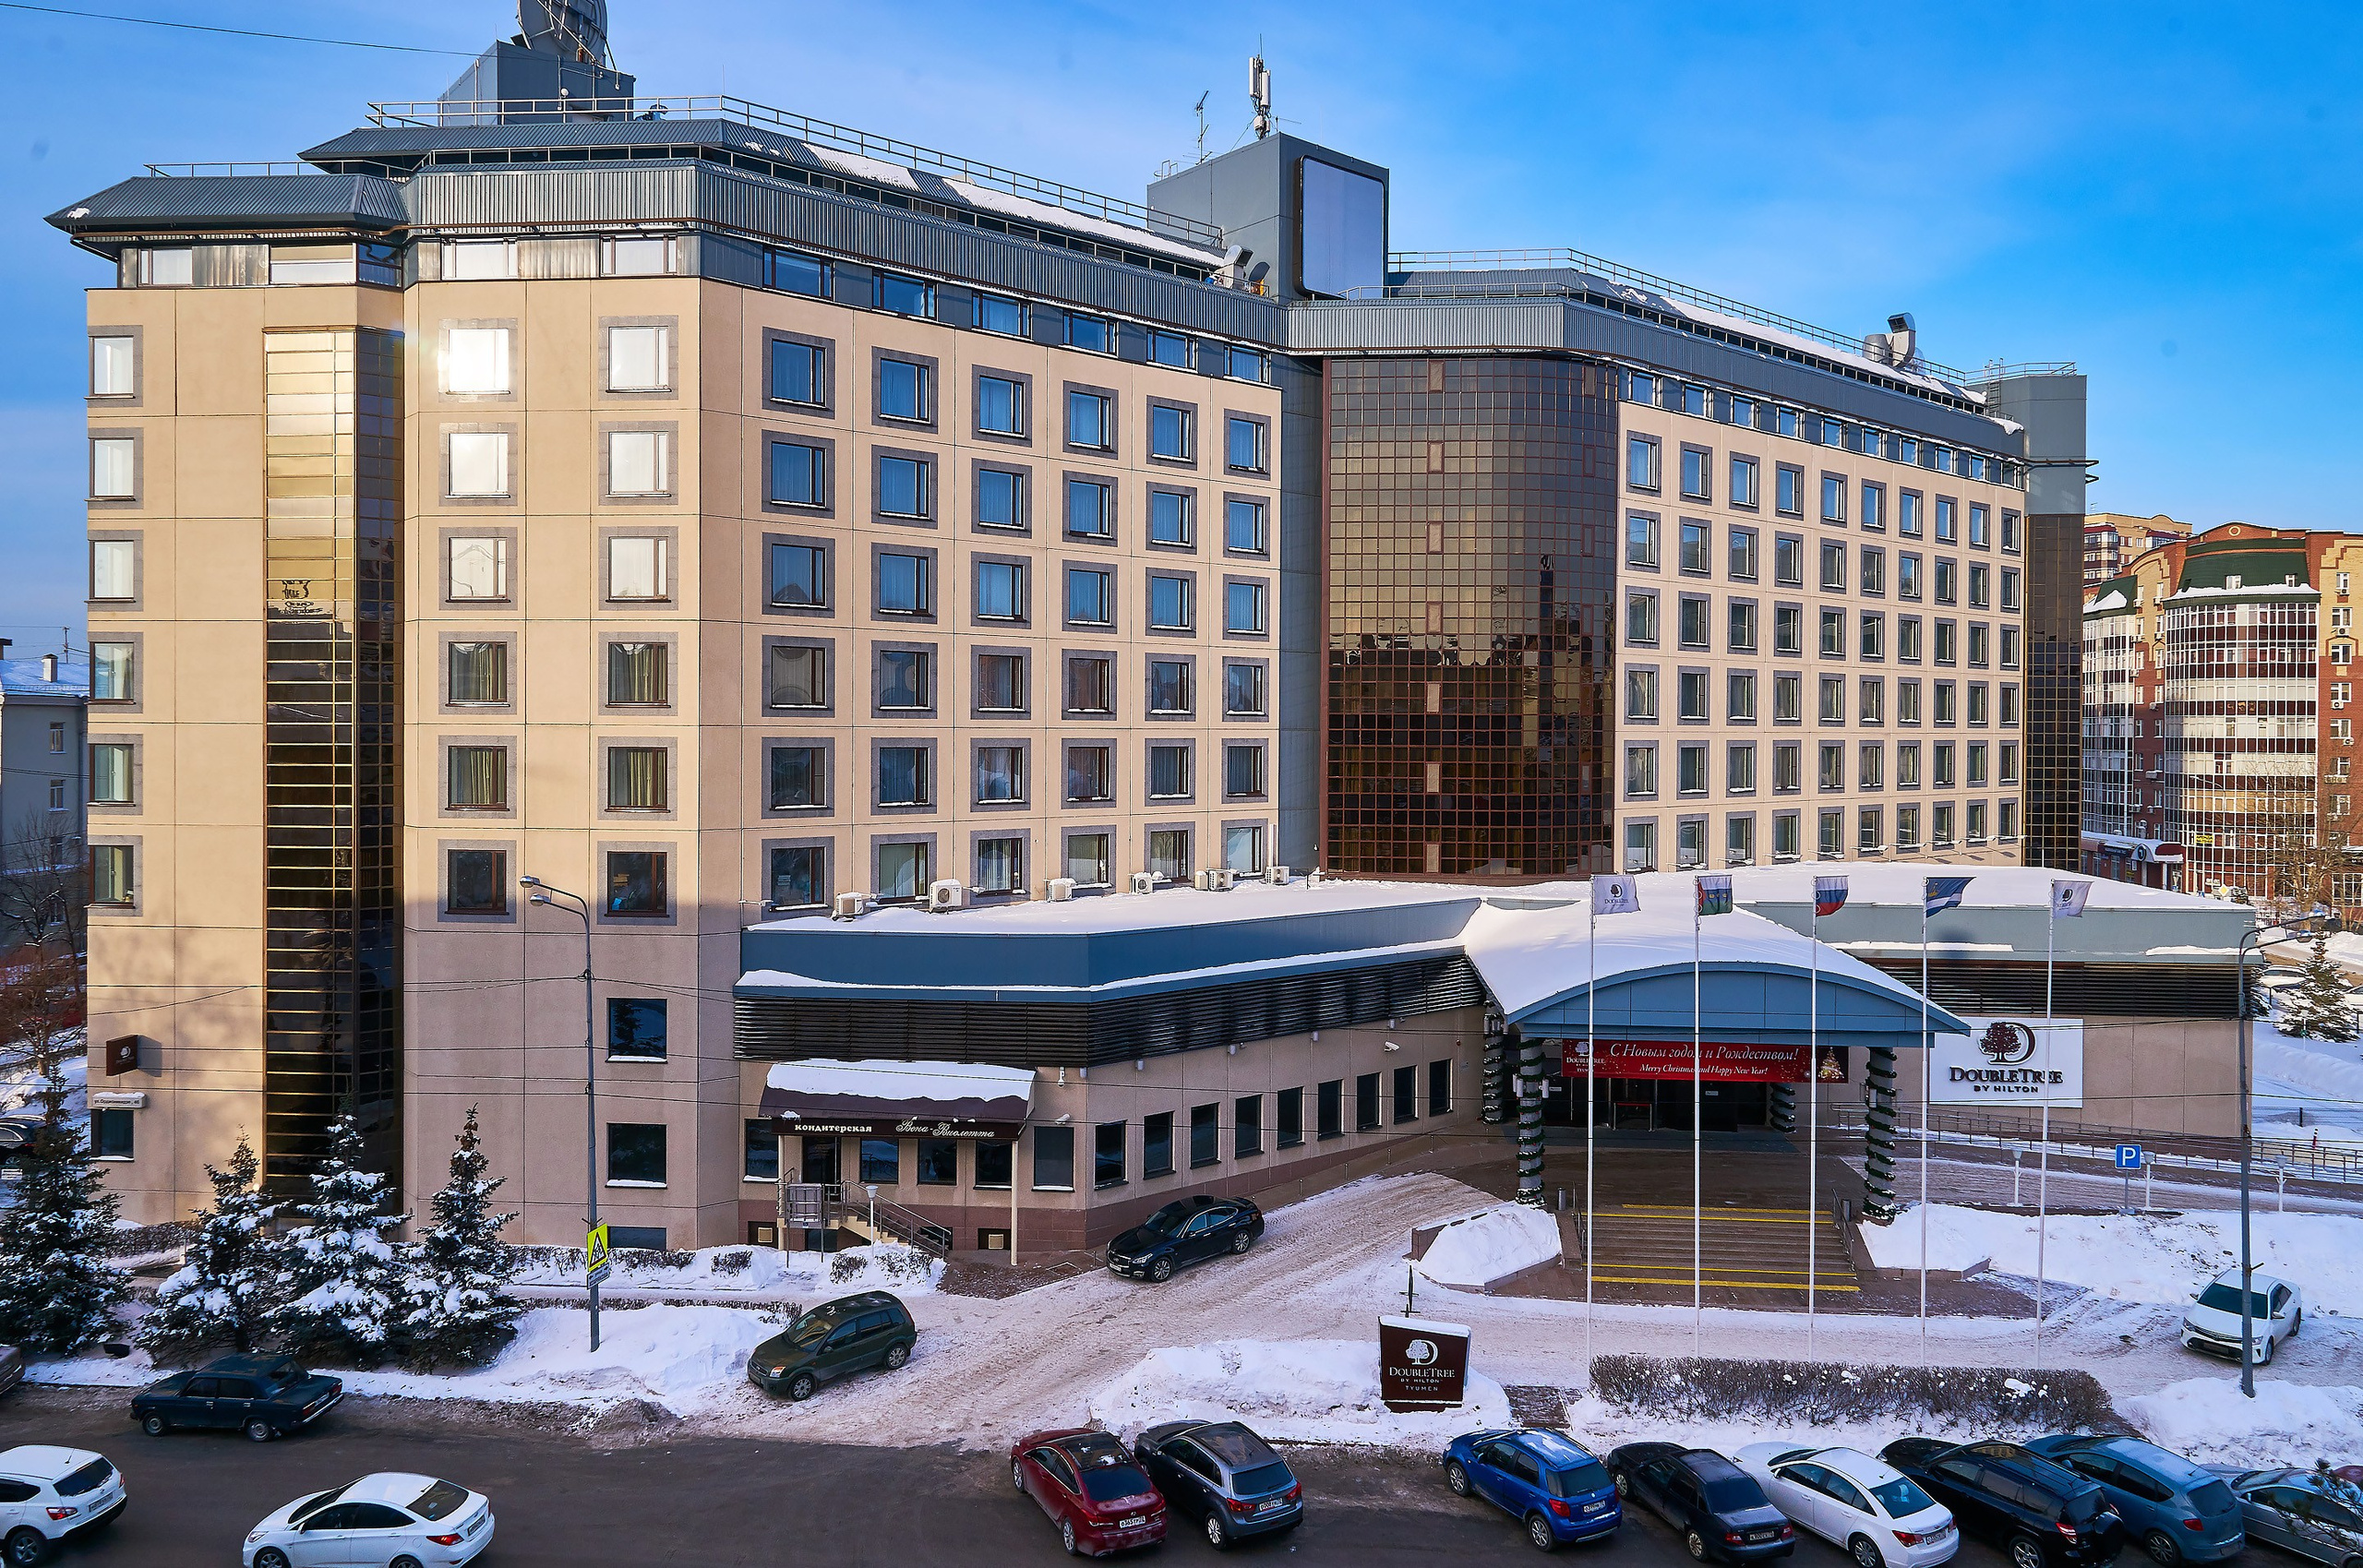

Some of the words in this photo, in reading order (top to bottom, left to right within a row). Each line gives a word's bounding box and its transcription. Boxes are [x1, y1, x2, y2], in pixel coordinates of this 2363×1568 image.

[1622, 1044, 1667, 1058] Новым
[1705, 1049, 1713, 1059] и
[1716, 1046, 1799, 1060] Рождеством!
[1639, 1063, 1662, 1075] Merry
[1710, 1065, 1733, 1077] Happy
[1733, 1066, 1750, 1074] New
[1750, 1066, 1769, 1075] Year!
[1949, 1066, 2063, 1083] DOUBLETREE
[794, 1123, 872, 1133] кондитерская
[2121, 1147, 2137, 1166] P
[1389, 1366, 1456, 1378] DOUBLETREE
